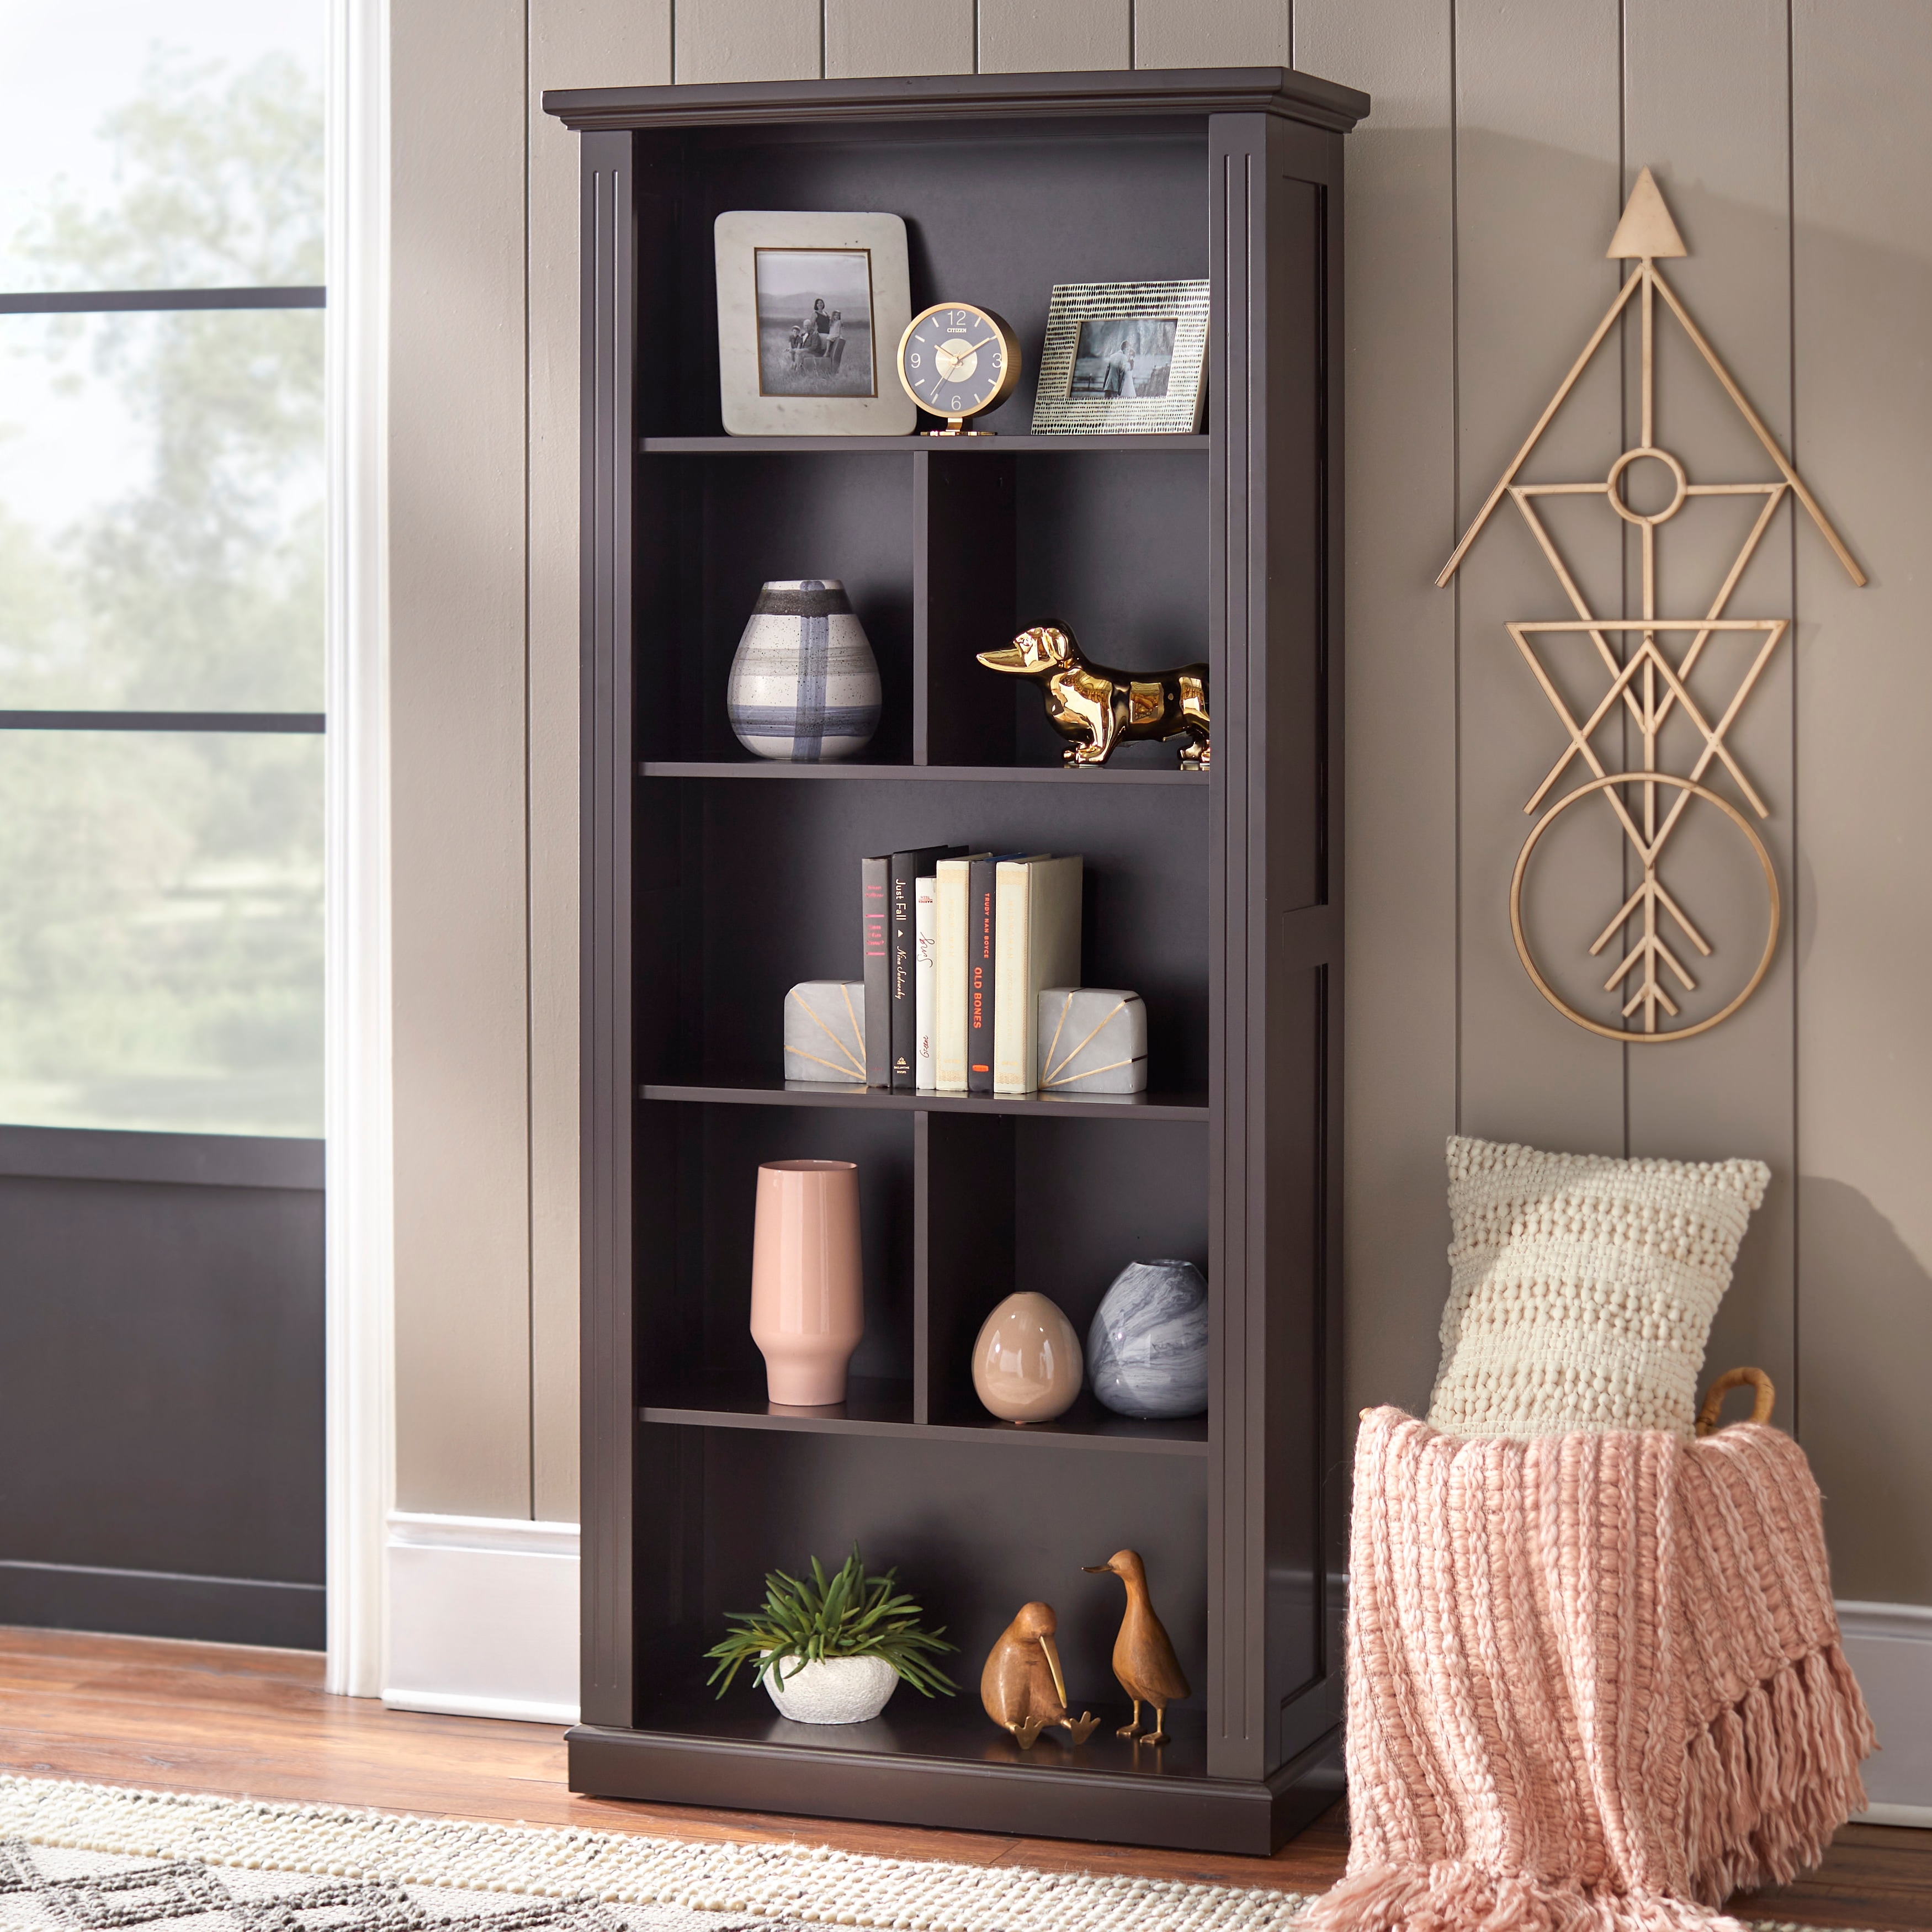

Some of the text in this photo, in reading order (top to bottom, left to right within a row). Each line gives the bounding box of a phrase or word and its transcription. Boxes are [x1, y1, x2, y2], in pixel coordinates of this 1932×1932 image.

[947, 310, 967, 326] 12
[910, 353, 921, 368] 9
[992, 353, 1002, 368] 3
[951, 395, 961, 411] 6
[895, 878, 906, 920] Just Fall
[917, 932, 935, 968] Sing
[895, 946, 906, 1000] Nina Sadowsky
[973, 967, 983, 1028] OLD BONES
